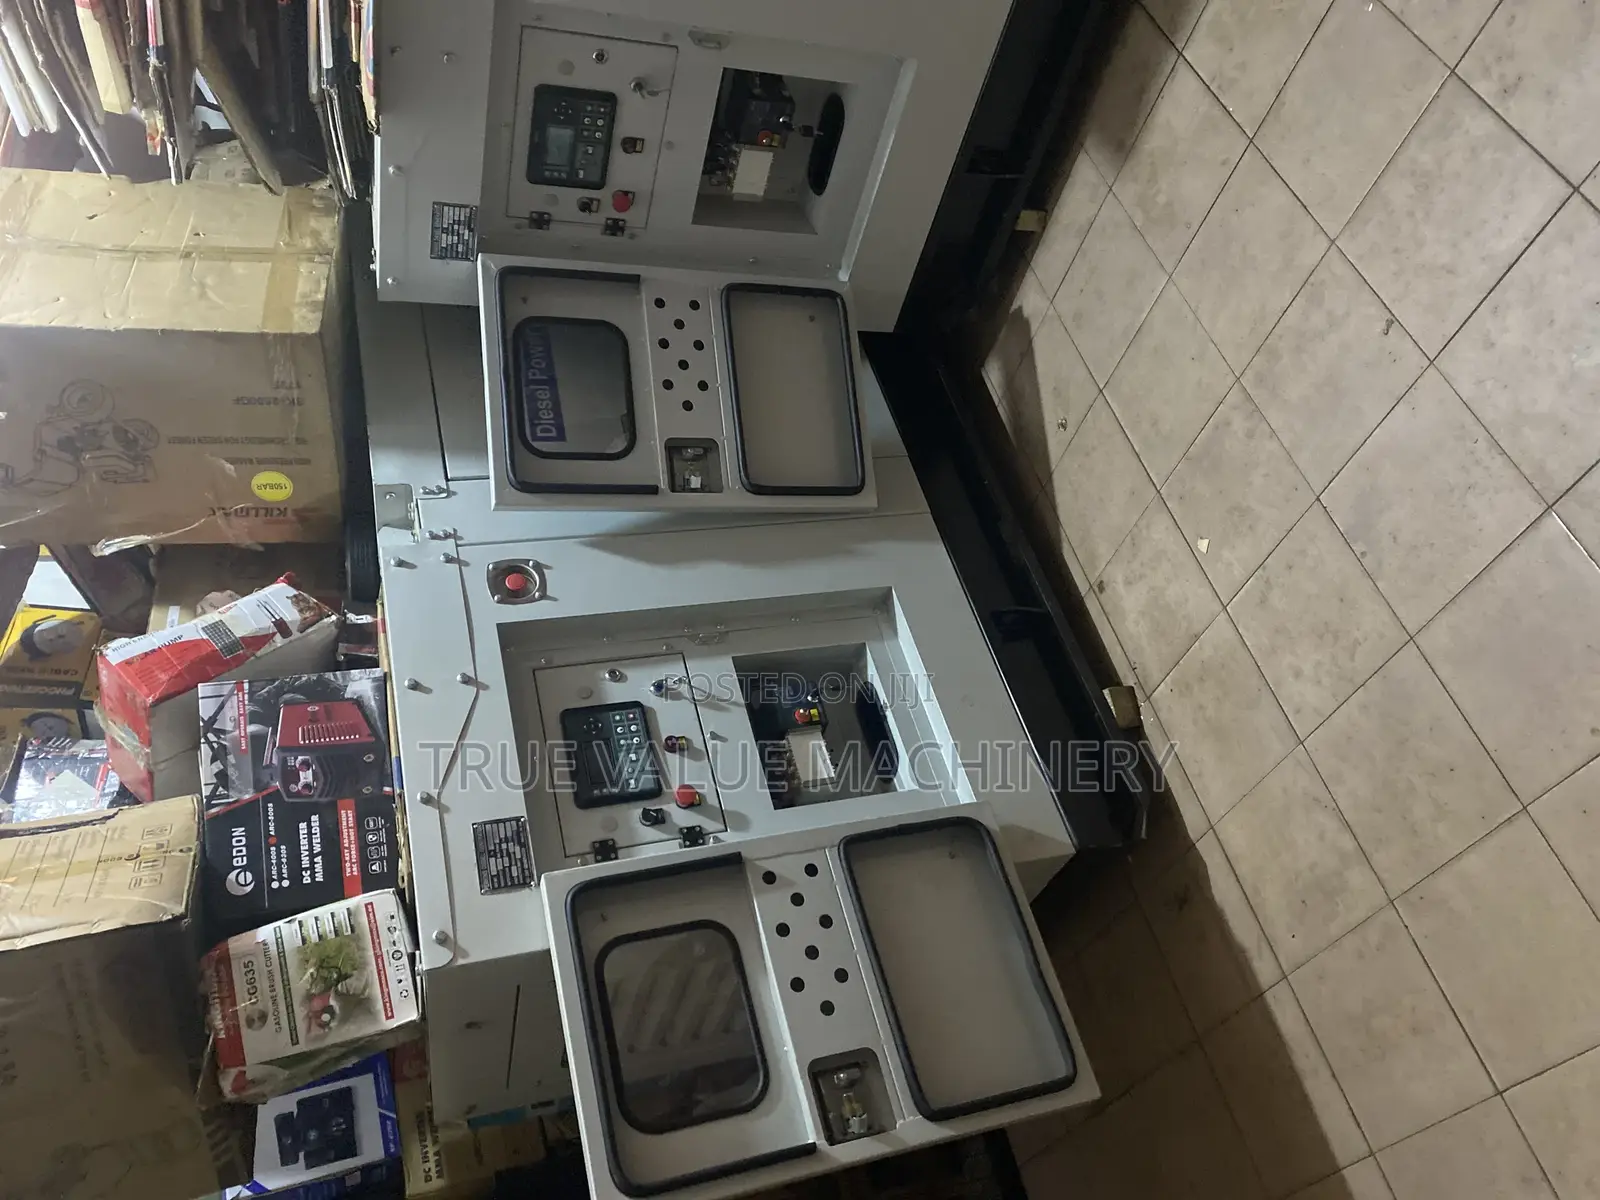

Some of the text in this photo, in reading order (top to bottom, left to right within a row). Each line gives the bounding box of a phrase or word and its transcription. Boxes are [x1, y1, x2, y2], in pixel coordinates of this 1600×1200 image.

[529, 385, 557, 437] Diesel
[255, 482, 288, 491] 150BAR
[158, 634, 184, 649] PUMP
[270, 846, 278, 881] ARC-400S
[299, 821, 311, 884] DC INVERTER
[310, 813, 324, 882] MMA WELDER
[243, 960, 259, 1005] CG635
[262, 940, 283, 1034] GASOLINE BRUSH CUTTER
[422, 1167, 433, 1183] DC
